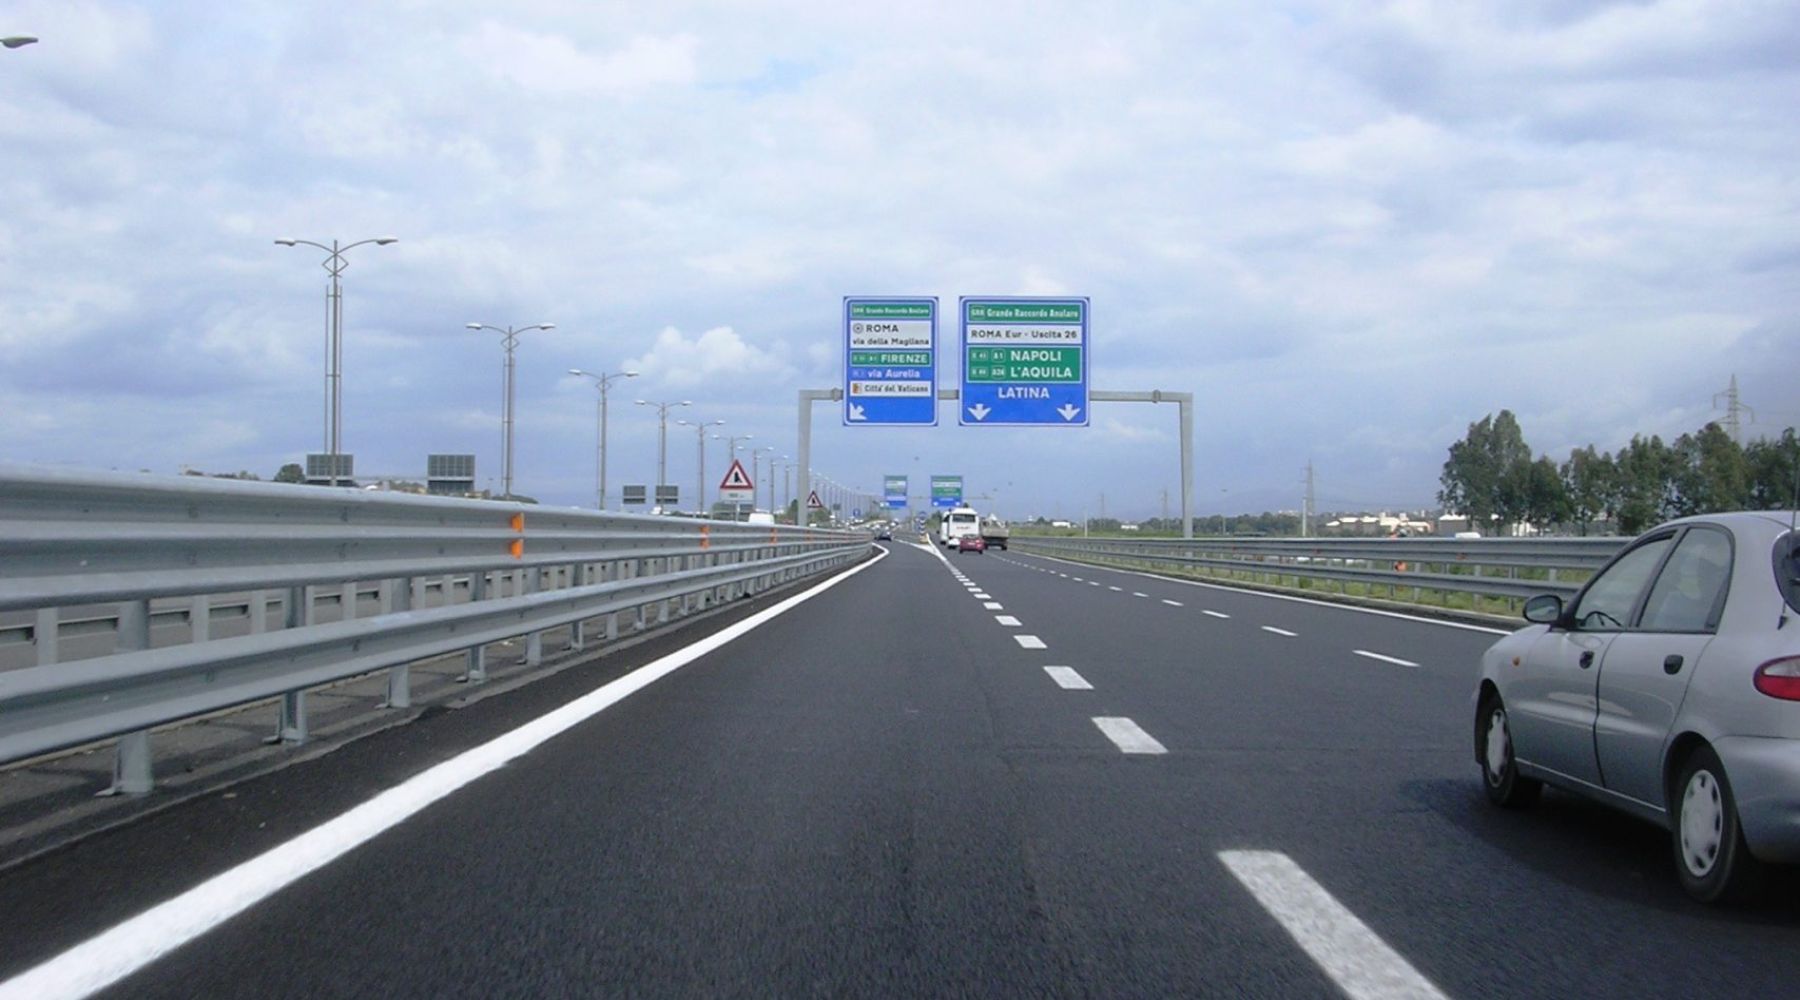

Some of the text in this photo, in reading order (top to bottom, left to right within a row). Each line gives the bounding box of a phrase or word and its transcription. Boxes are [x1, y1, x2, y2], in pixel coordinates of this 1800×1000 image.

[987, 309, 1013, 317] Grande
[1015, 309, 1048, 317] Raccordo
[1049, 309, 1078, 317] Anulare
[866, 324, 899, 332] ROMA
[971, 330, 1002, 338] ROMA
[1005, 330, 1022, 338] Eur
[1031, 330, 1062, 338] Uscita
[1064, 330, 1077, 338] 26
[891, 338, 929, 346] Magliana
[881, 354, 928, 363] FIRENZE
[1010, 350, 1062, 361] NAPOLI
[868, 369, 882, 377] via
[885, 369, 920, 377] Aurelia
[1010, 367, 1072, 378] L'AQUILA
[884, 384, 895, 392] del
[897, 384, 929, 392] Vaticano
[998, 387, 1050, 398] LATINA
